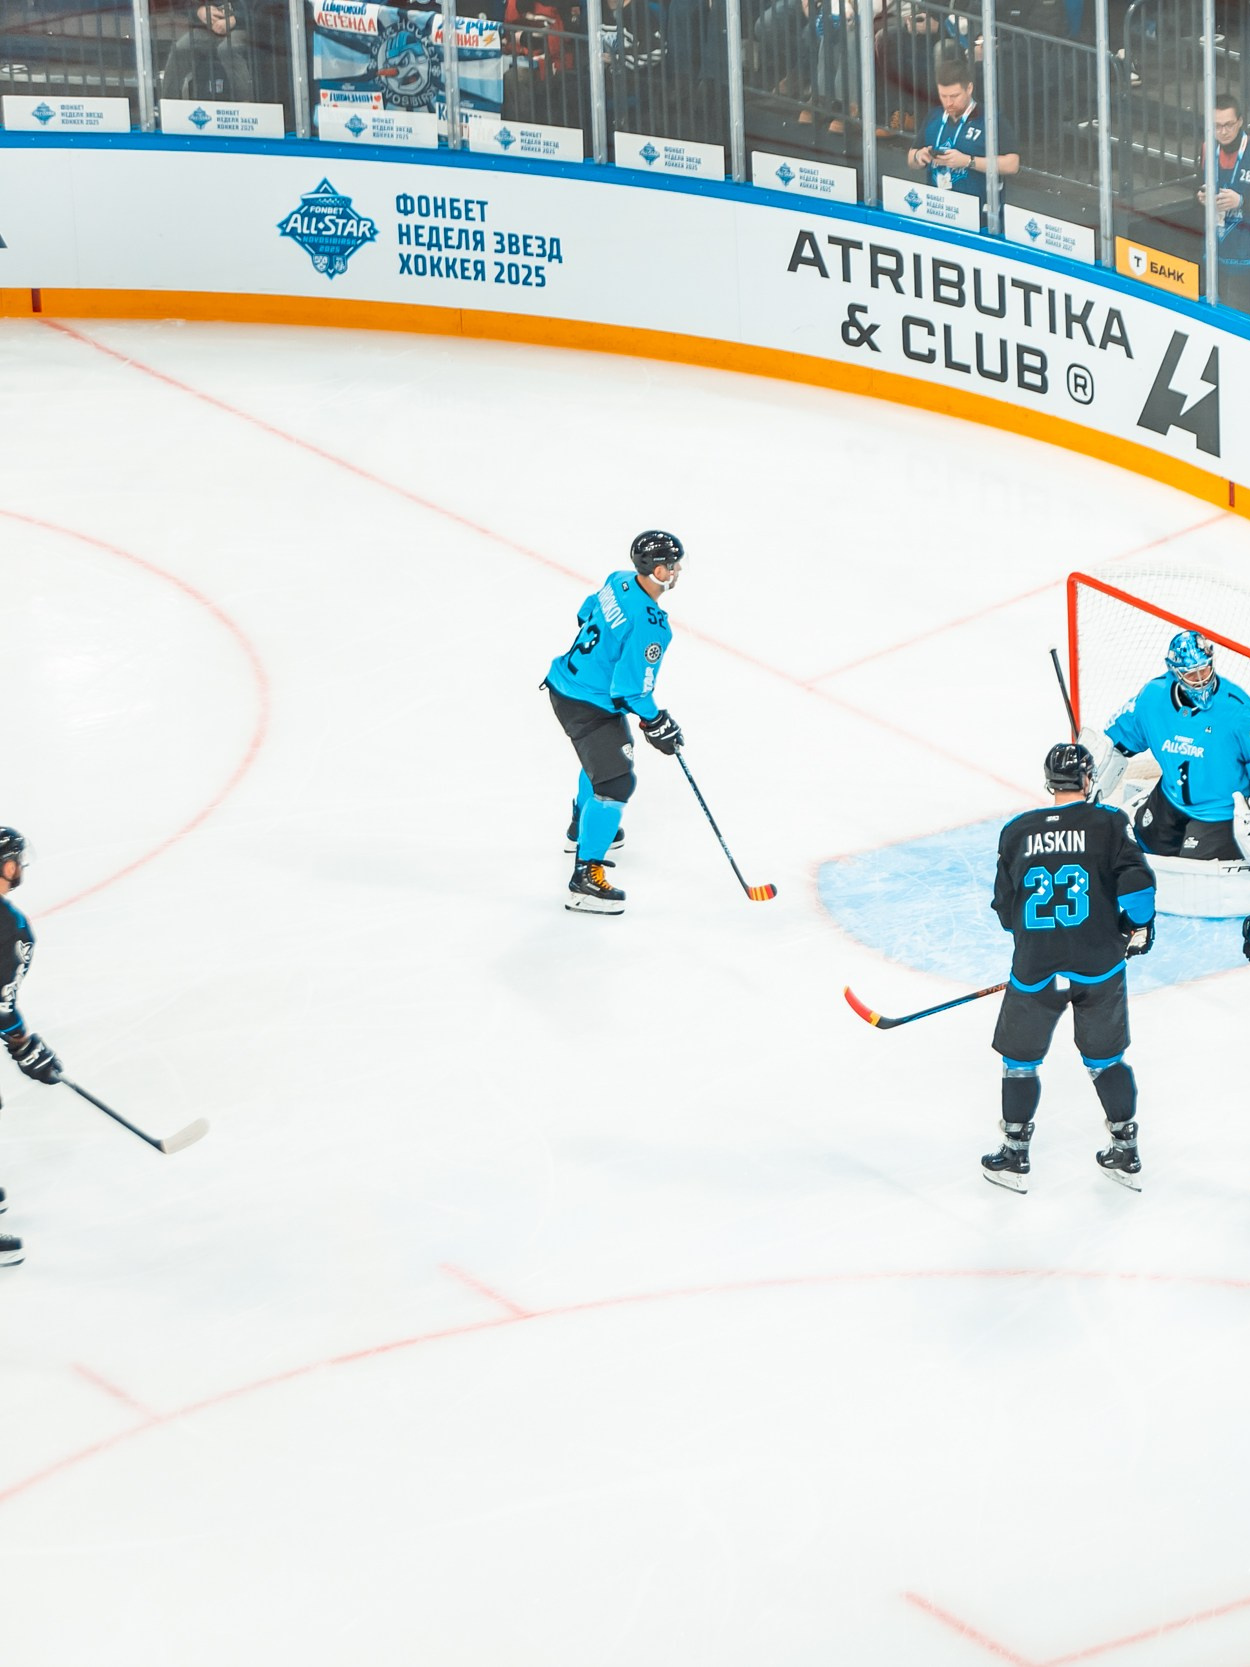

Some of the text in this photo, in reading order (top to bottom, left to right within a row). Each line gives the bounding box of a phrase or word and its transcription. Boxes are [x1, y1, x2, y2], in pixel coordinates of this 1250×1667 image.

[965, 127, 981, 141] 57
[309, 206, 344, 215] FONBET
[395, 193, 488, 222] ФОНБЕТ
[397, 223, 563, 264] НЕДЕЛЯ ЗВЕЗД
[398, 252, 546, 287] ХОККЕЯ 2025
[1150, 262, 1184, 284] БАНК
[787, 230, 1134, 360] ATRIBUTIKA
[841, 302, 881, 352] &
[902, 315, 1049, 395] CLUB
[646, 606, 669, 630] 52
[1177, 760, 1193, 806] 1
[1024, 830, 1086, 857] JASKIN
[1023, 864, 1089, 929] 23
